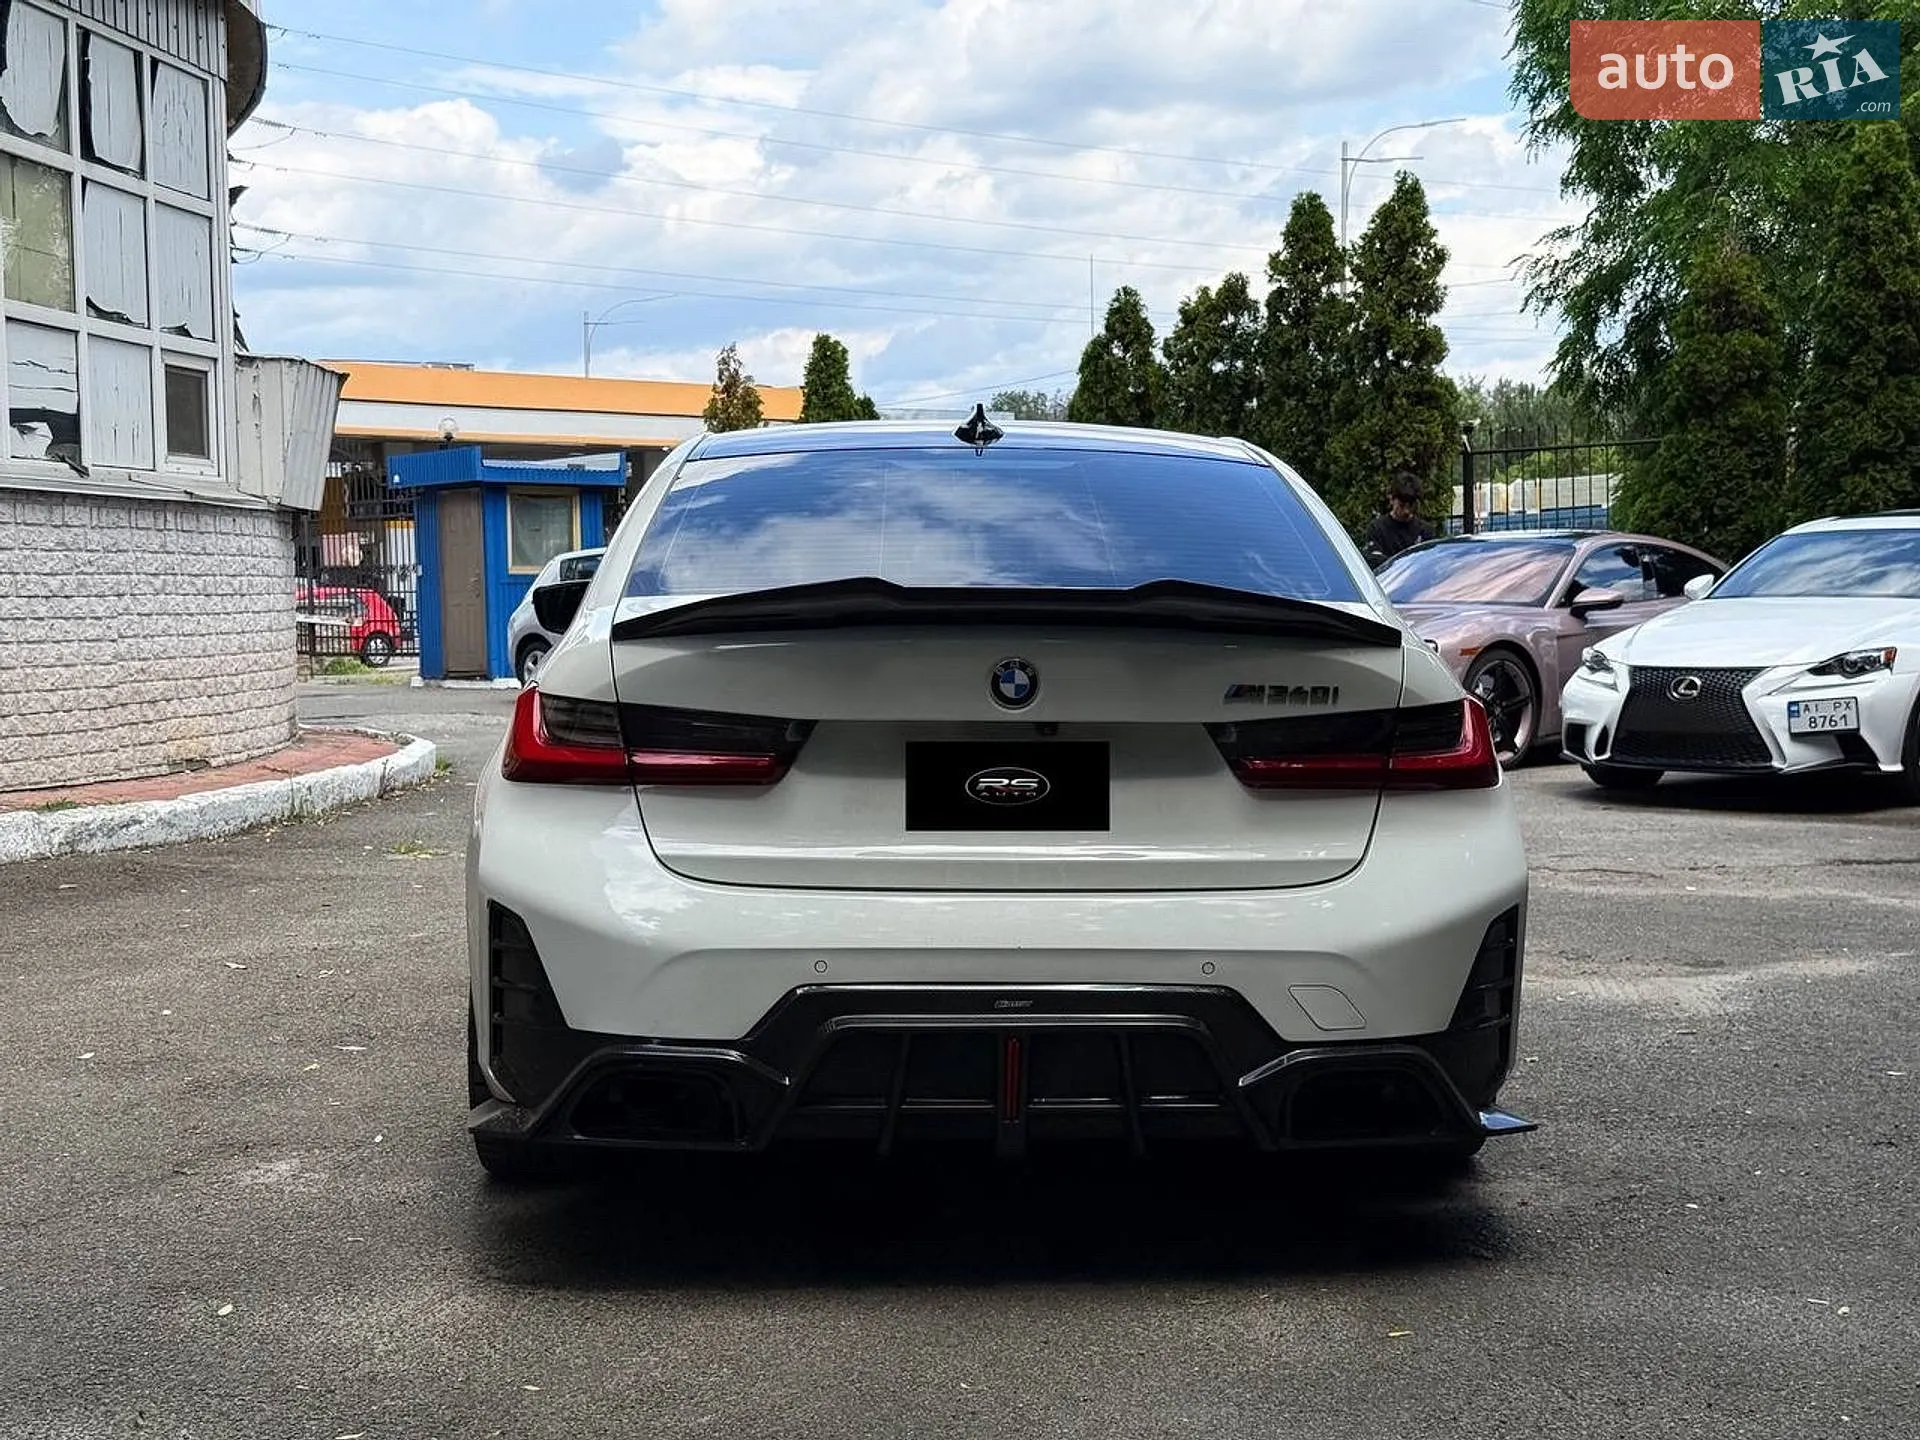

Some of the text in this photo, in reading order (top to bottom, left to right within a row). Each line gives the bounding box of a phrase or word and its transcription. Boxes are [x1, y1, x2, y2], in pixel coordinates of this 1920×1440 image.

[1803, 700, 1852, 714] AI PX
[1808, 713, 1849, 729] 8761
